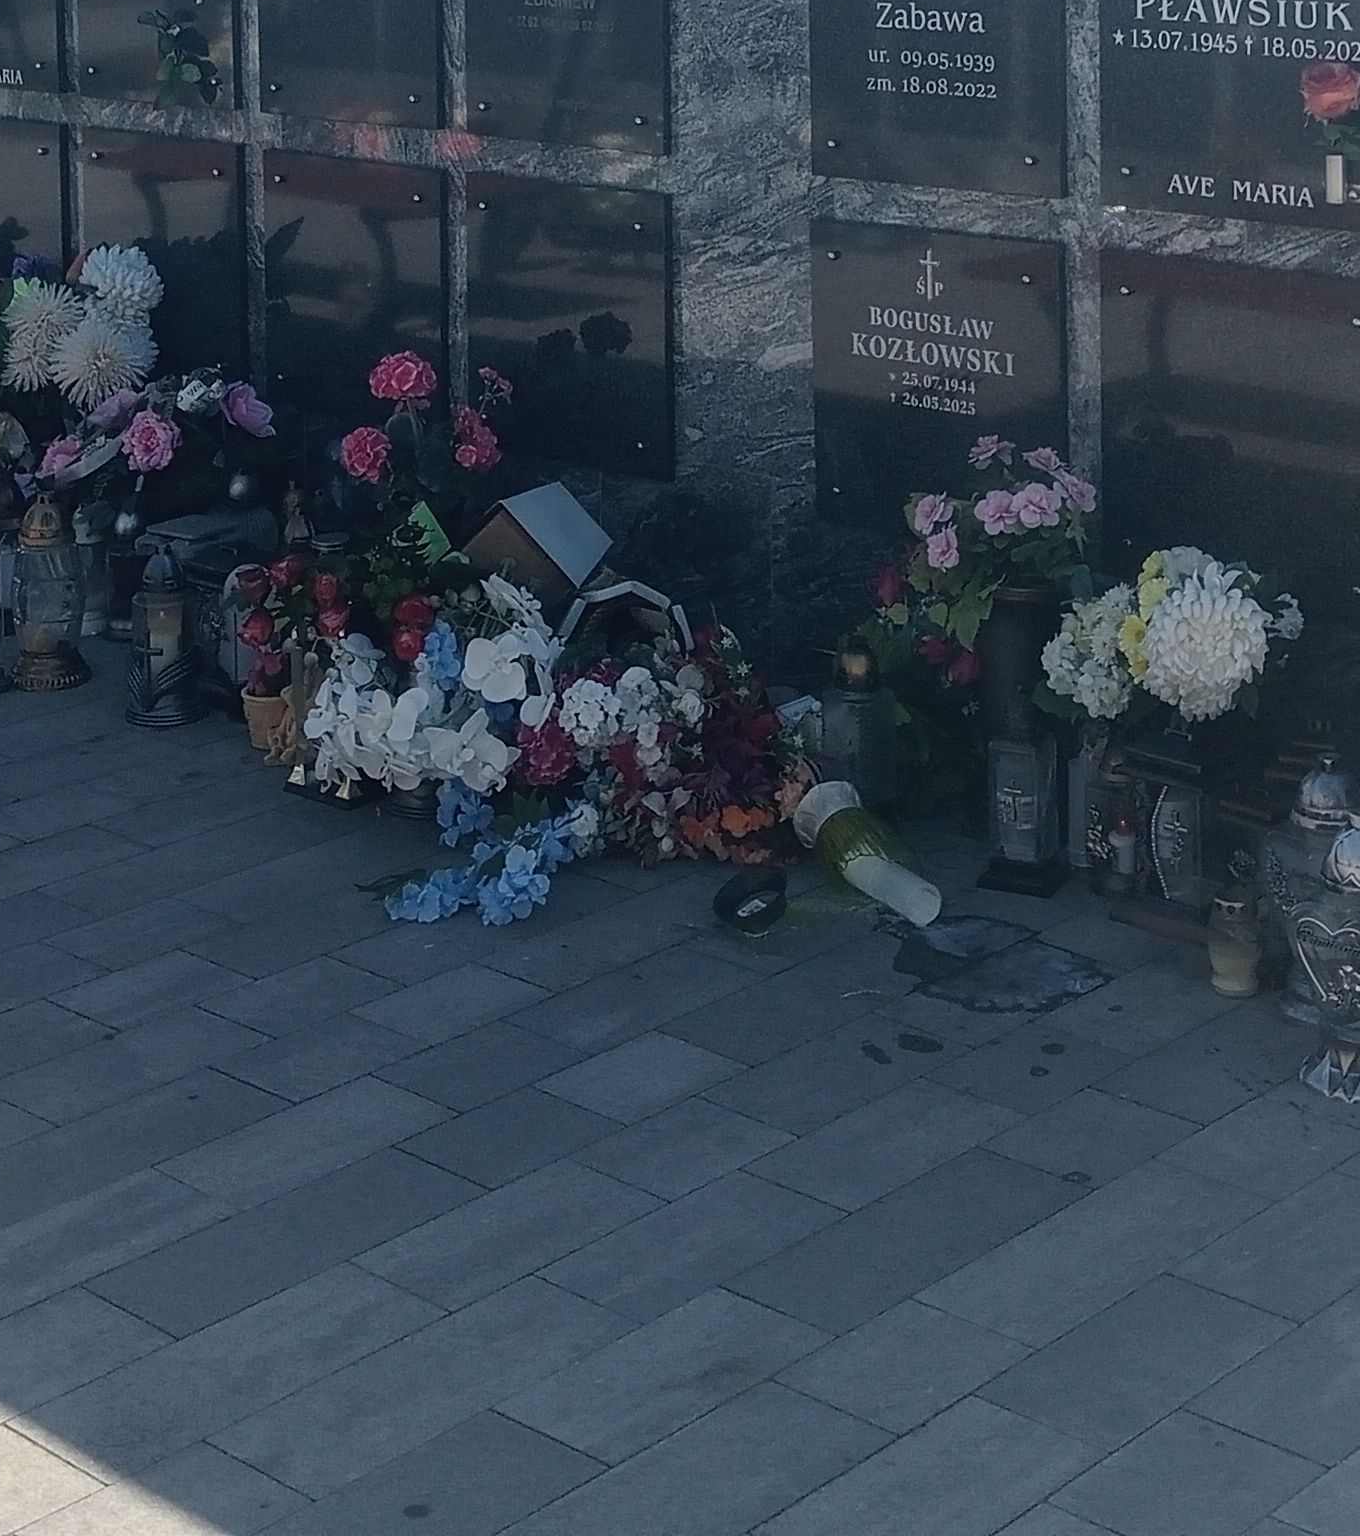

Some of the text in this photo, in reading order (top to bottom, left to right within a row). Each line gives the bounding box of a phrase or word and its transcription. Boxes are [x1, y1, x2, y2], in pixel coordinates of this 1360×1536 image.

[876, 2, 986, 33] Zabawa
[1130, 29, 1238, 54] 13.07.1945
[868, 49, 995, 73] ur. 09.05.1939
[866, 76, 997, 99] zm. 18.08.2022
[1167, 174, 1314, 208] AVE MARIA
[916, 276, 944, 297] Ś P
[869, 306, 994, 340] BOGUSŁAW
[851, 332, 1015, 376] KOZŁOWSKI
[902, 371, 977, 395] 25.07.1944
